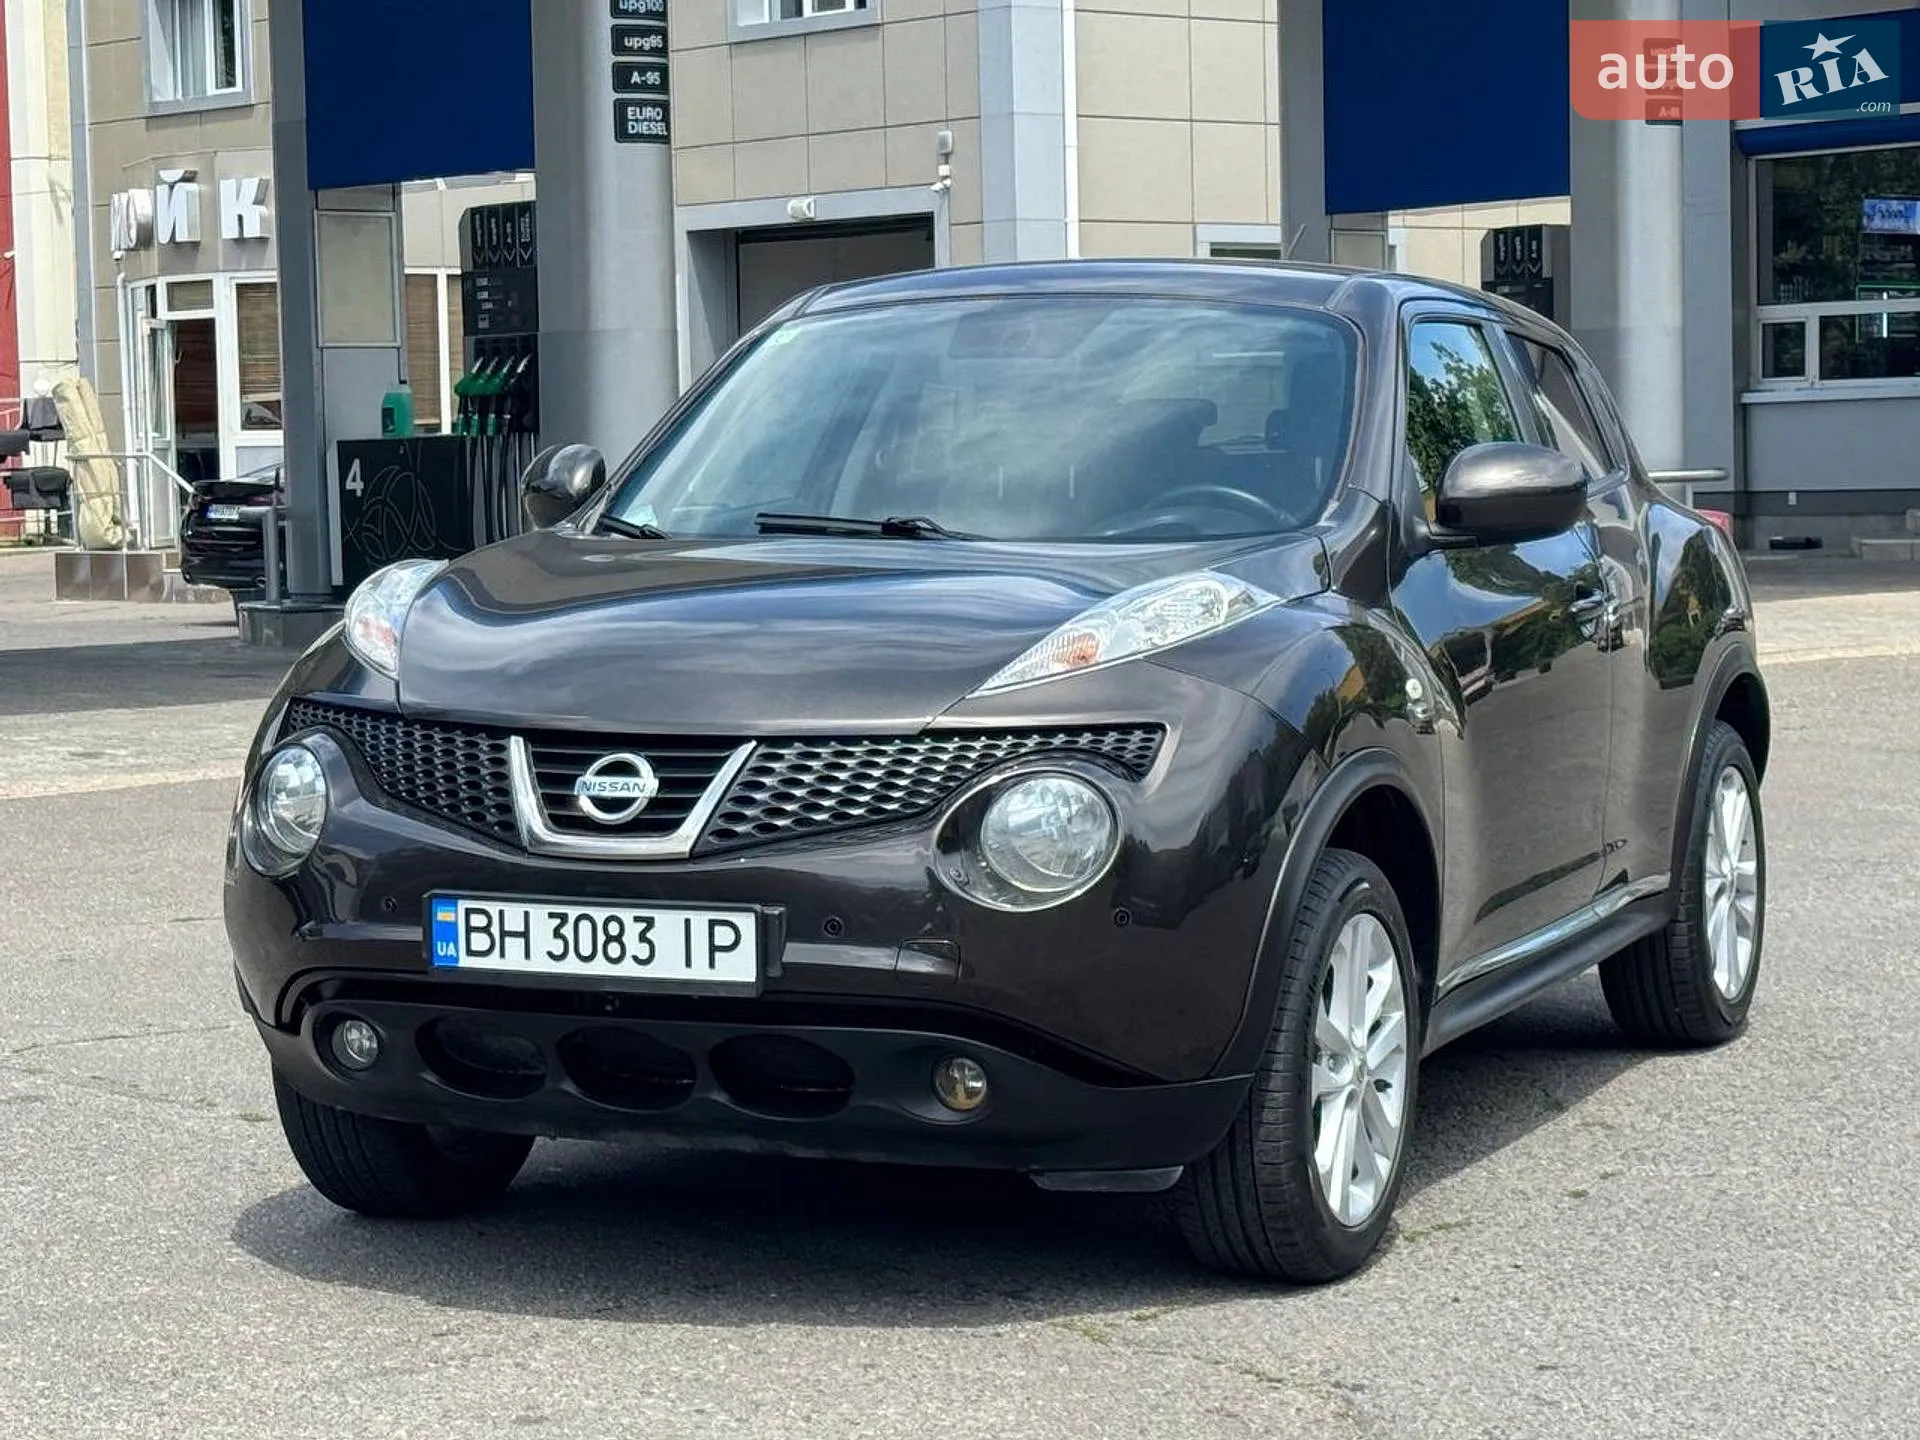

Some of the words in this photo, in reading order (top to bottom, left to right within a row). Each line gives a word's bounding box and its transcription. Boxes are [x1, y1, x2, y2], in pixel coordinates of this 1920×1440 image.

[629, 70, 662, 86] A-95
[626, 106, 663, 120] EURO
[627, 120, 669, 136] DIESEL
[345, 457, 365, 497] 4
[580, 780, 647, 794] NISSAN
[464, 906, 532, 961] BH
[545, 911, 656, 967] 3083
[683, 916, 743, 970] IP
[436, 940, 458, 959] UA
